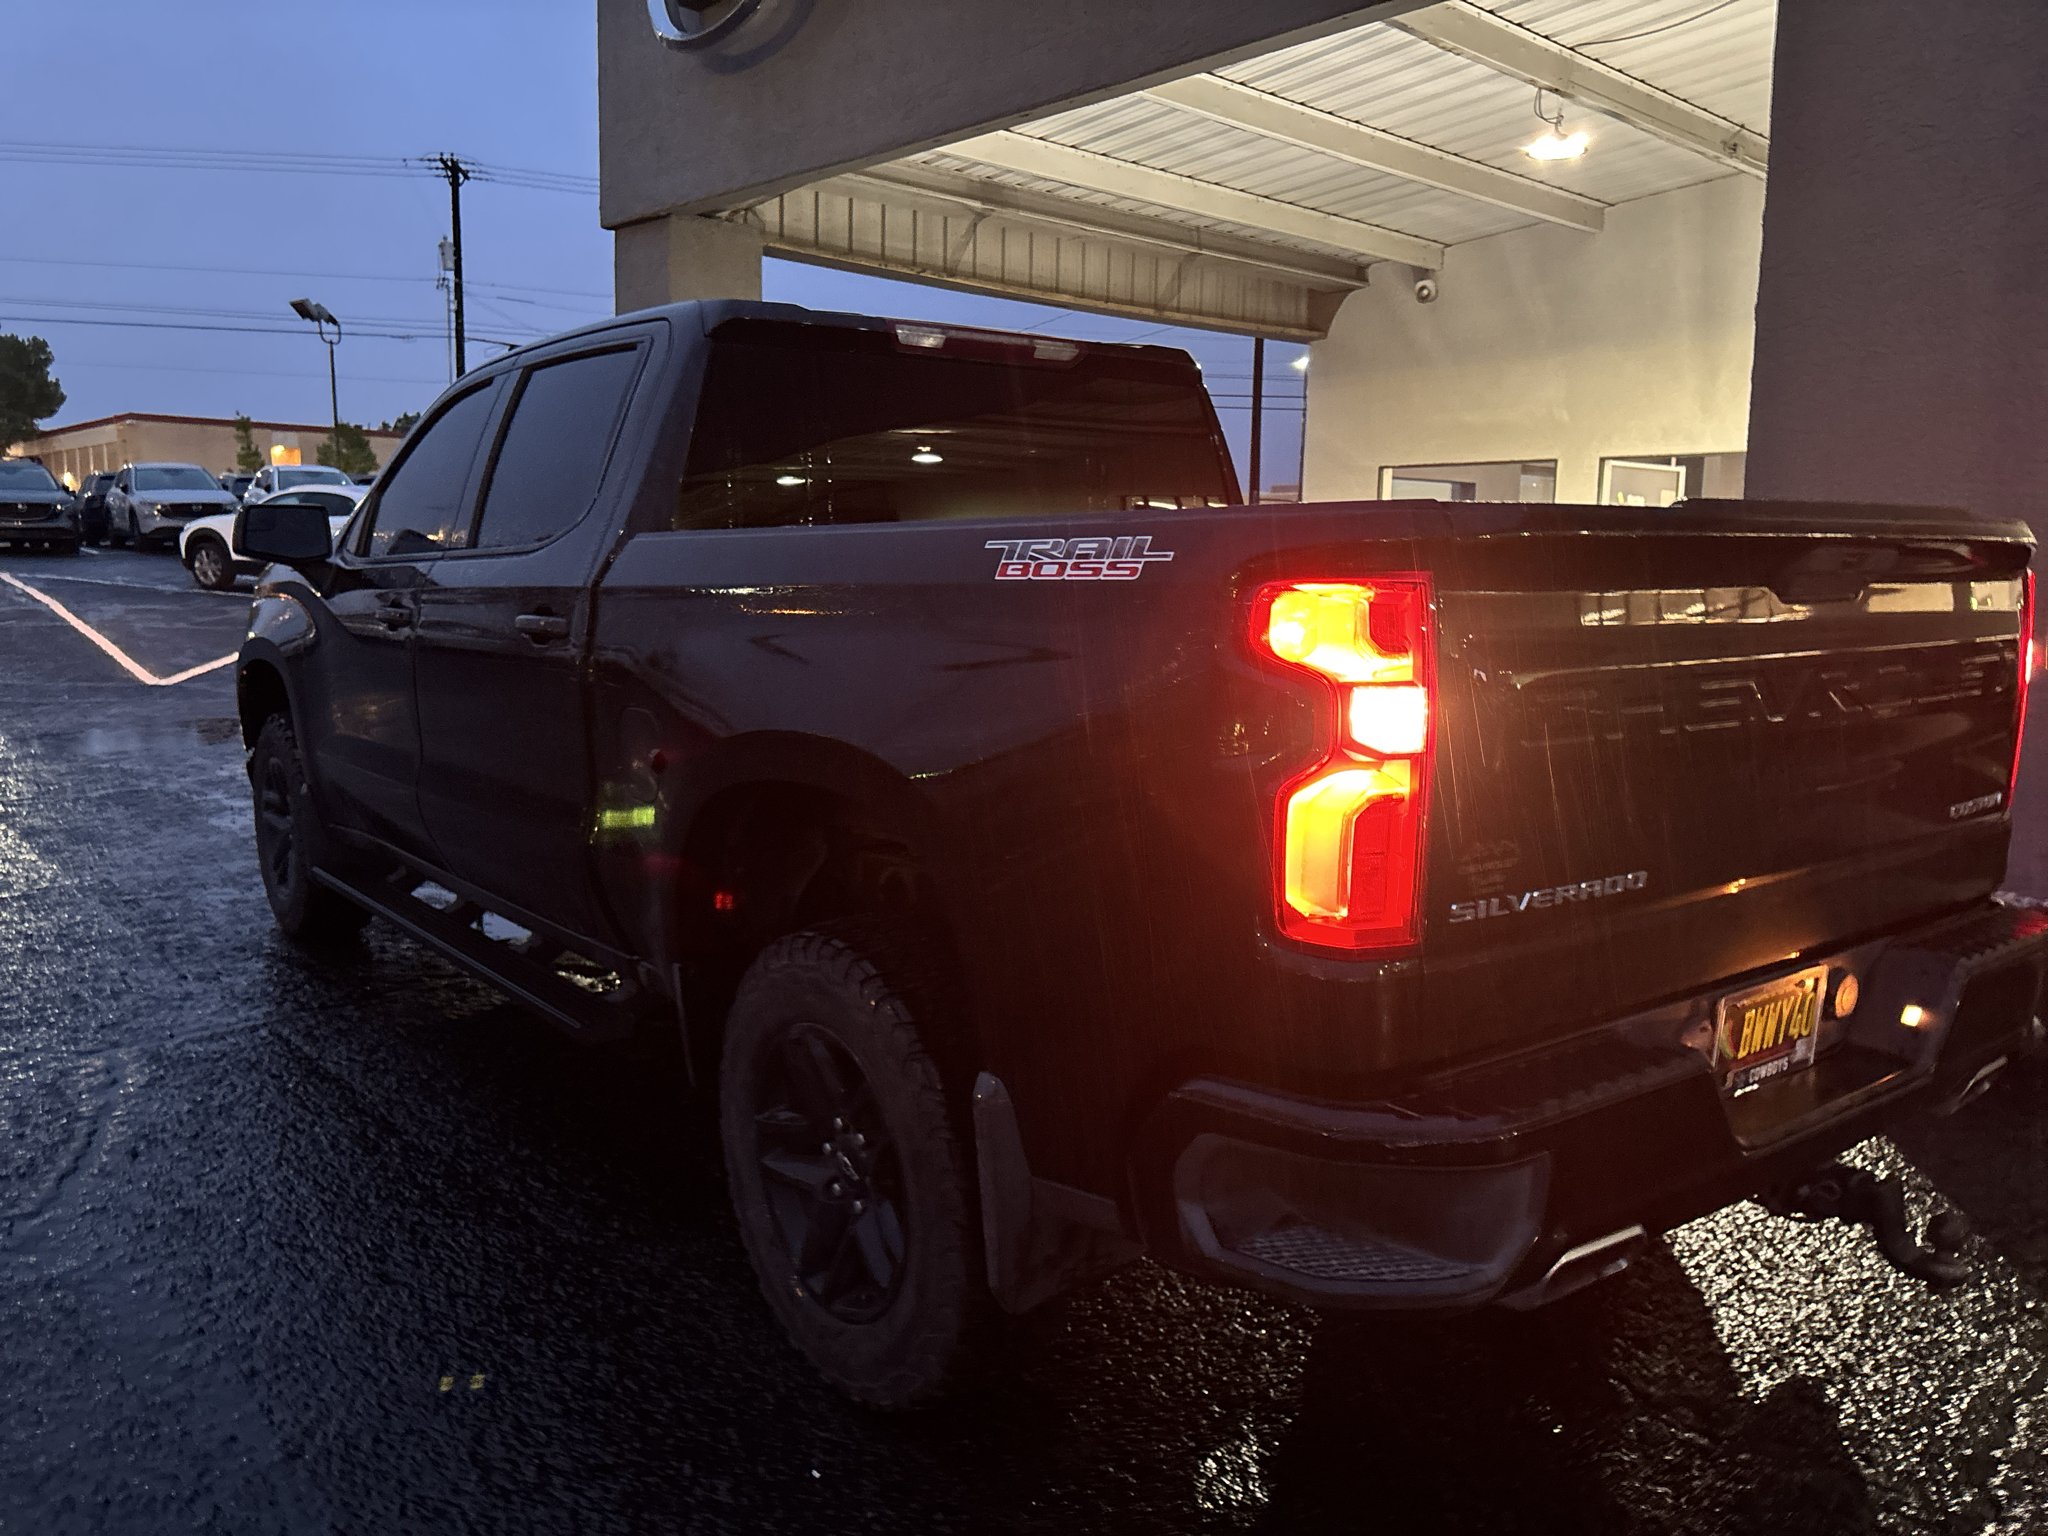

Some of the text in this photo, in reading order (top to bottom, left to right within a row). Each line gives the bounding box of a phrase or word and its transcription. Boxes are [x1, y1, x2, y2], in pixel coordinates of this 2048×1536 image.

[985, 536, 1175, 561] TRAIL
[994, 560, 1144, 580] BOSS
[1449, 870, 1648, 923] SILVERADO
